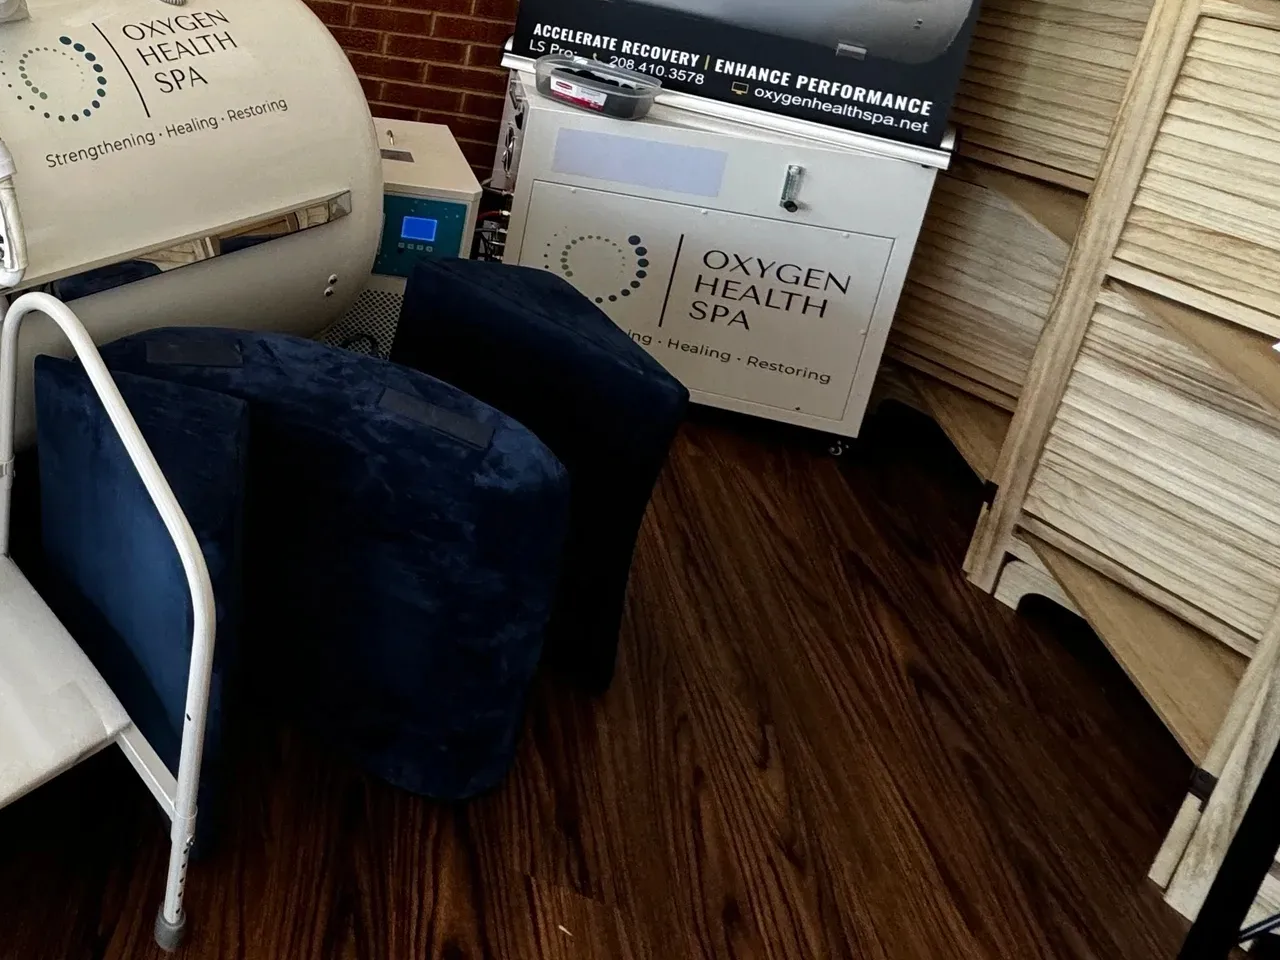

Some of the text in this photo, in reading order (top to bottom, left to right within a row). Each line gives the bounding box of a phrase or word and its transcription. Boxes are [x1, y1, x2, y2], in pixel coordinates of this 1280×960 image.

[122, 9, 231, 42] OXYGEN
[136, 30, 239, 67] HEALTH
[533, 23, 933, 117] ACCELERATE RECOVERY ENHANCE PERFORMANCE
[153, 66, 209, 94] SPA
[529, 39, 546, 52] LS
[609, 55, 704, 86] 208.410.3578
[754, 88, 930, 134] oxygenhealthspa.net
[44, 96, 289, 168] Strengthening Healing Restoring
[703, 249, 852, 296] OXYGEN
[688, 300, 751, 331] SPA
[693, 274, 829, 318] HEALTH
[668, 337, 732, 362] Healing
[747, 355, 832, 385] Restoring
